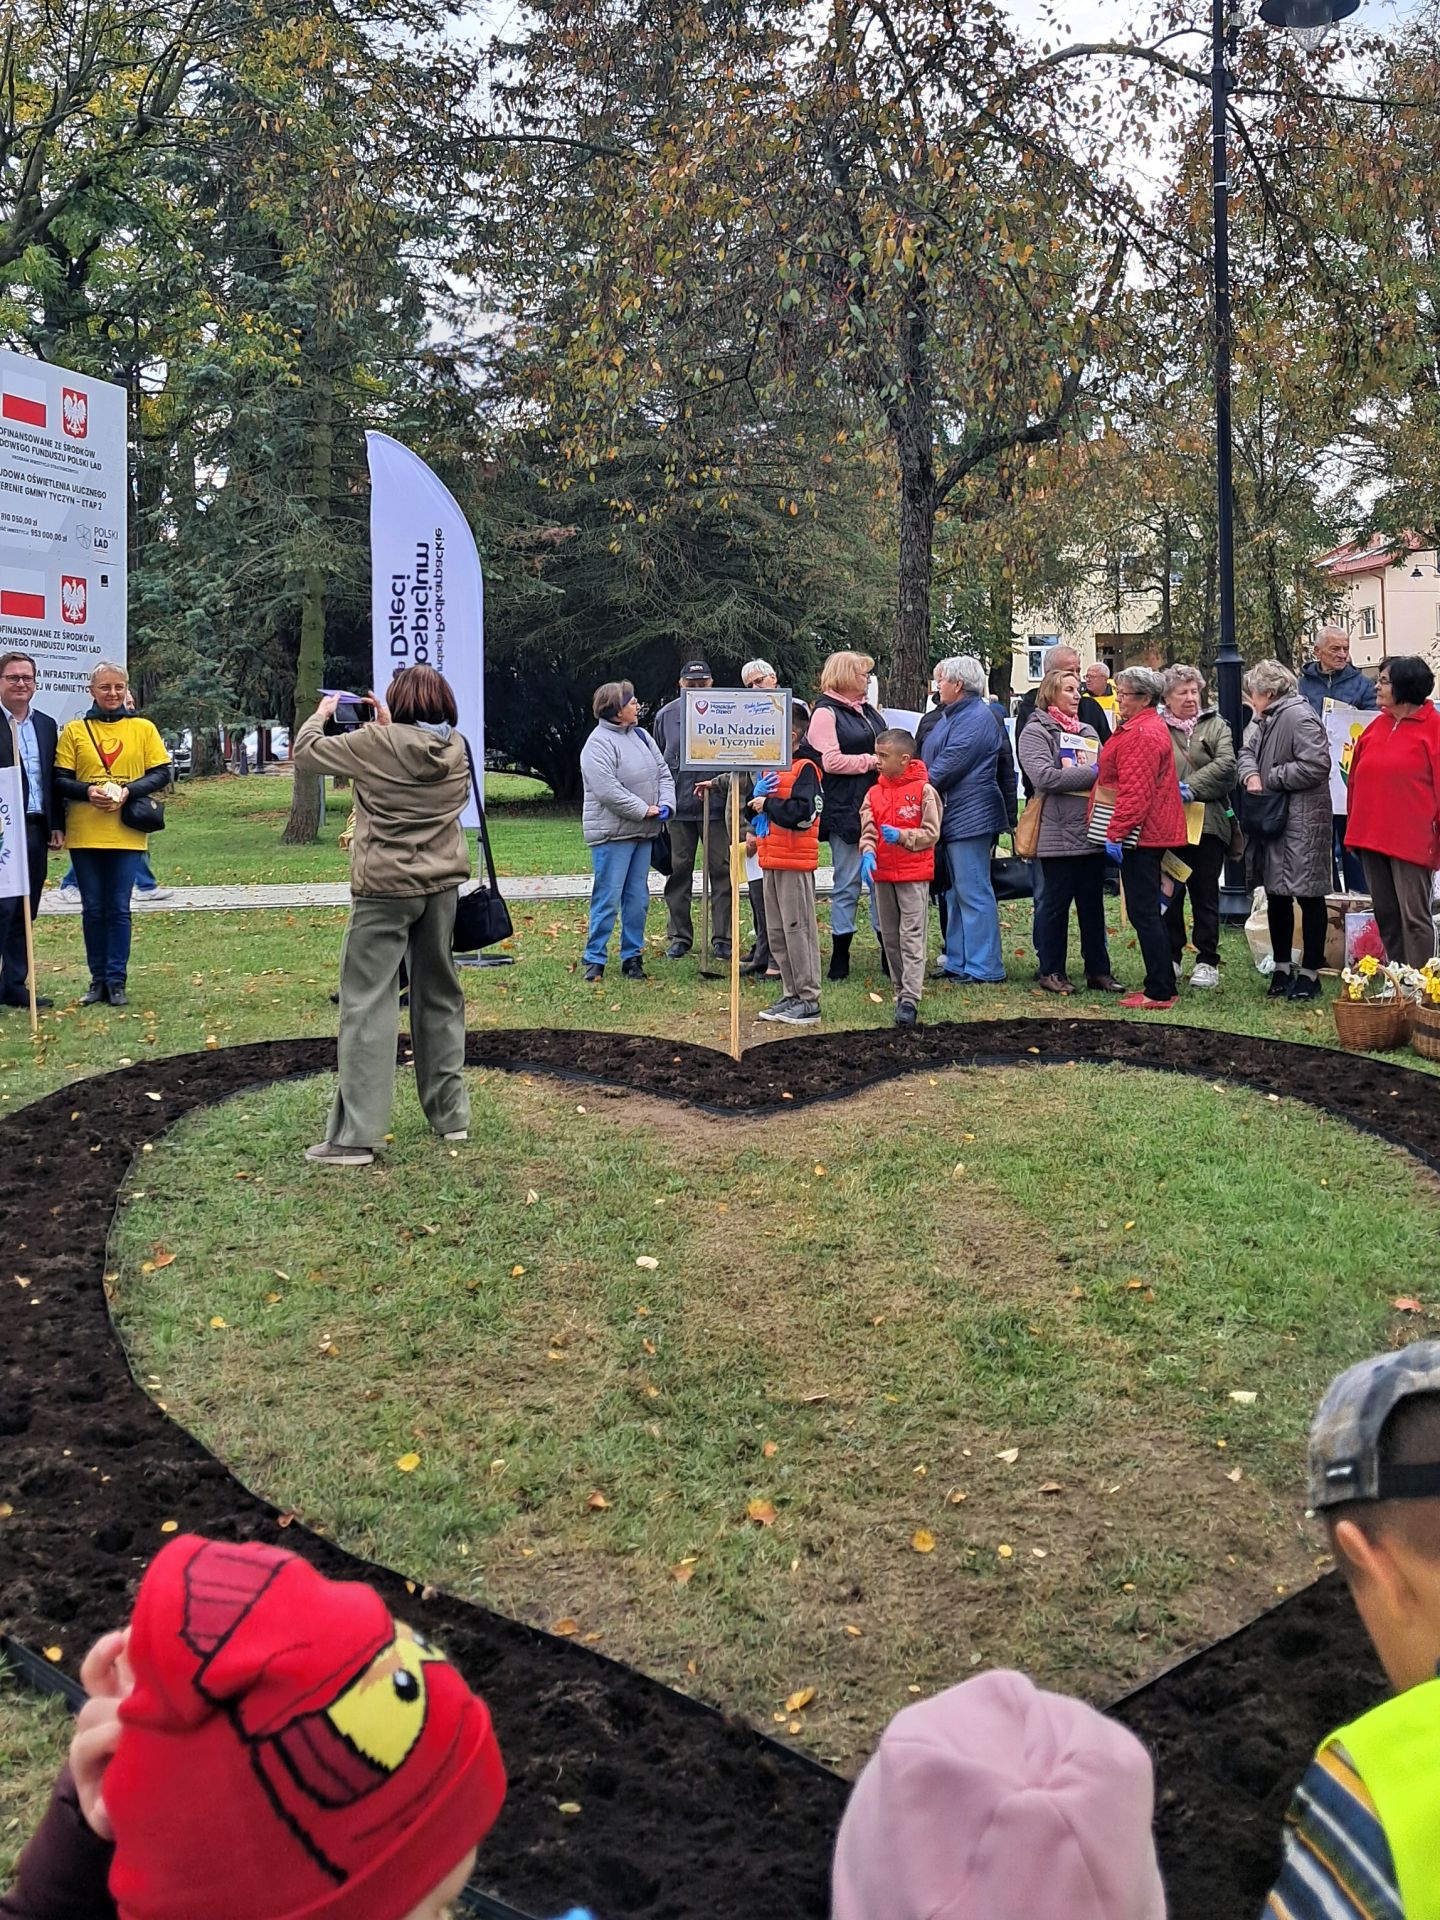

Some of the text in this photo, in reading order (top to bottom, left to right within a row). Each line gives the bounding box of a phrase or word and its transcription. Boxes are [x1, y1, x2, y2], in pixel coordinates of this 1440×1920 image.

[31, 446, 66, 462] FUNDUSZU
[67, 455, 88, 468] POLSKI
[54, 441, 62, 450] ZE
[63, 441, 96, 459] ŚRODKÓW
[26, 472, 70, 492] OŚWIETLENIA
[72, 484, 107, 500] ULICZNEGO
[25, 487, 48, 499] GMINY
[49, 492, 75, 504] TYCZYN
[81, 499, 98, 510] ETAP
[98, 502, 102, 511] 2
[94, 526, 120, 540] POLSKI
[94, 538, 109, 548] ŁAD
[53, 631, 60, 640] ZE
[62, 629, 95, 642] ŚRODKÓW
[30, 640, 65, 650] FUNDUSZU
[66, 644, 88, 652] POLSKI
[89, 646, 102, 654] ŁAD
[52, 684, 76, 692] GMINIE
[698, 723, 776, 736] Pola Nadziei
[708, 737, 765, 748] w Tyczynie
